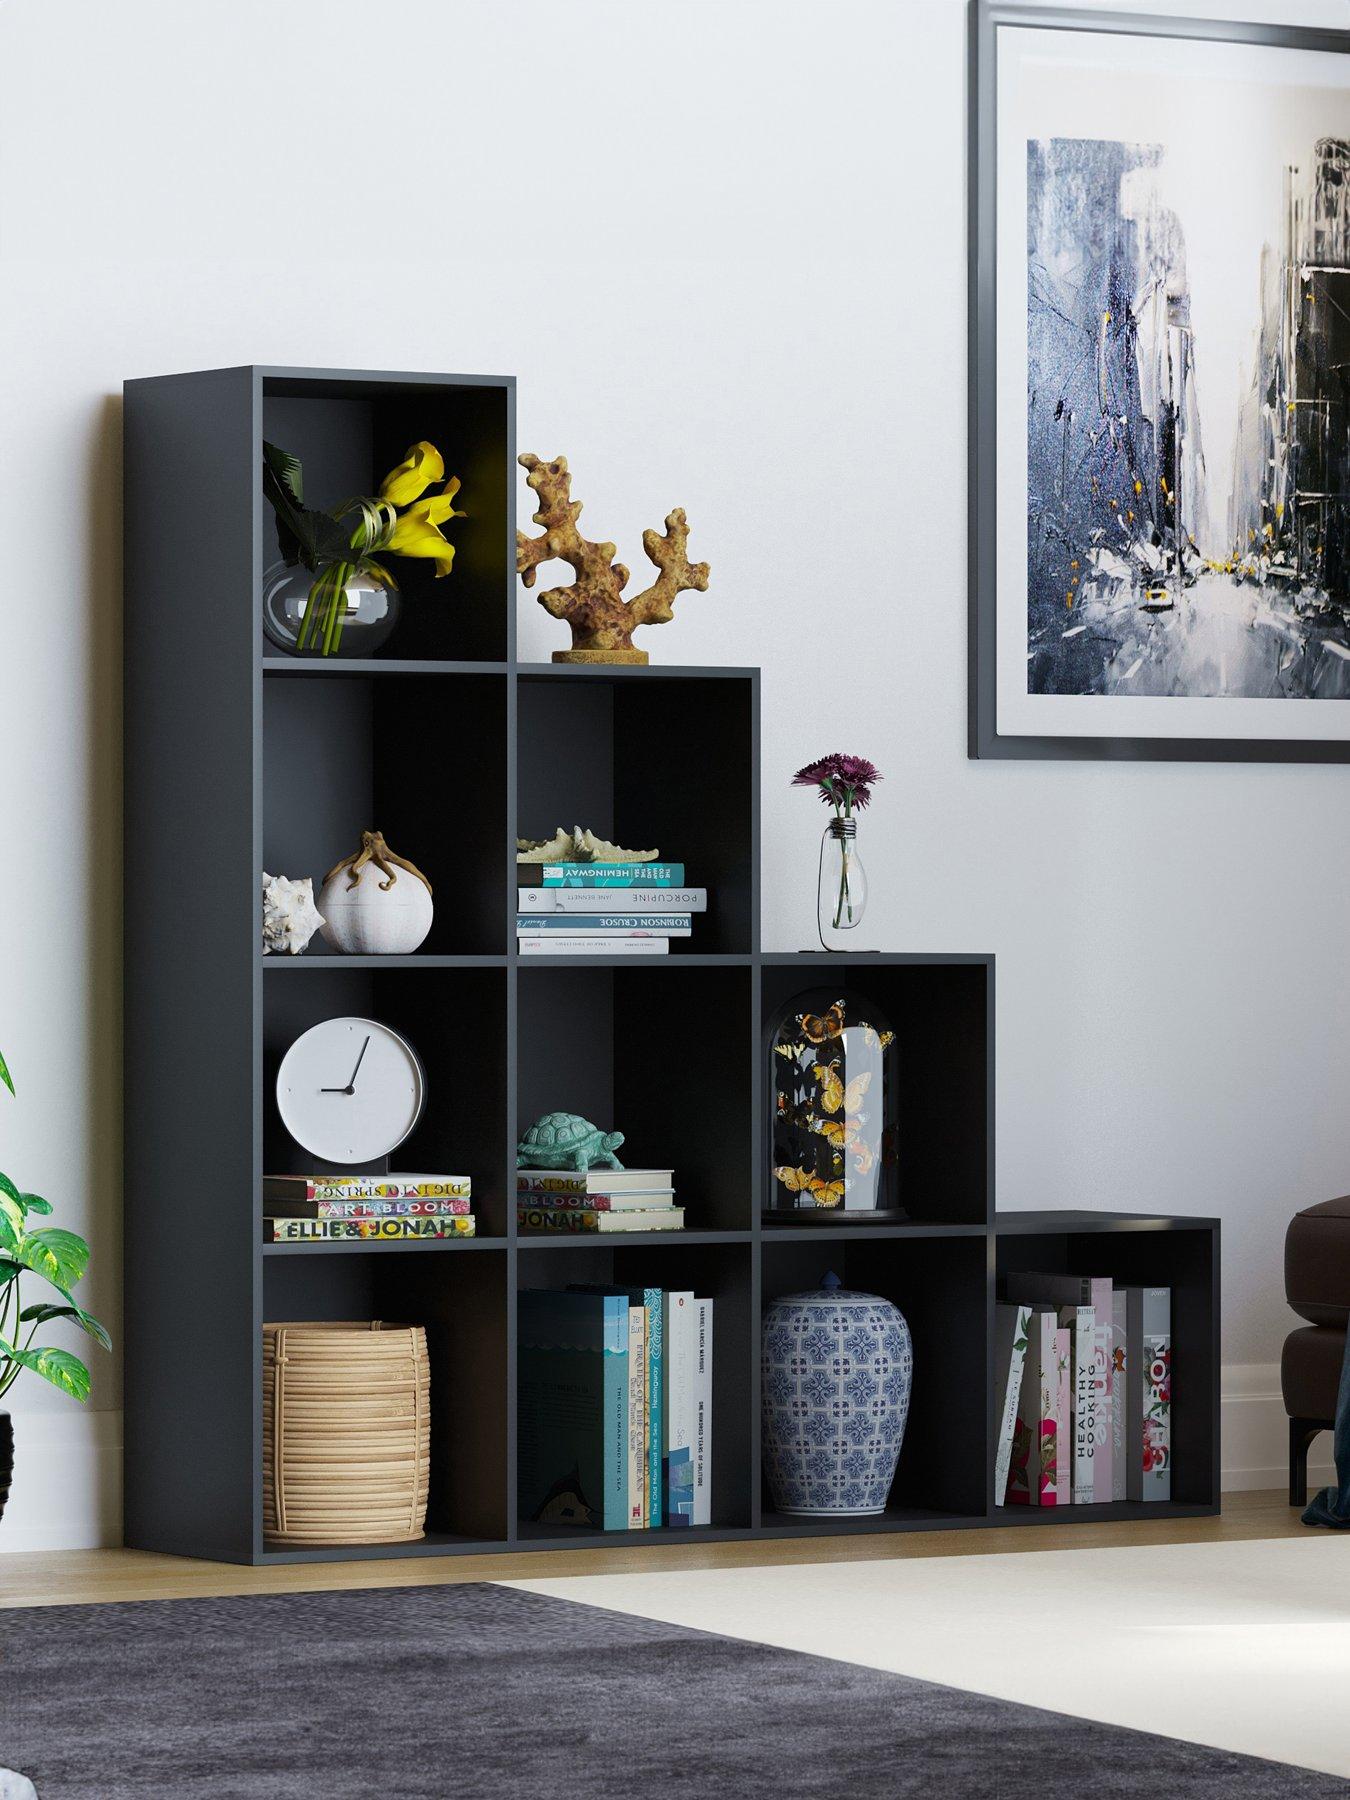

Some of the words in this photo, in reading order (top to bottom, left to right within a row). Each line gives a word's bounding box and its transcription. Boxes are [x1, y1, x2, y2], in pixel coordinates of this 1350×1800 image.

[565, 869, 629, 877] HEMINGWAY
[632, 893, 697, 902] PORCUPINE
[599, 918, 638, 927] CRUSOE
[640, 918, 689, 927] ROBINSON
[323, 1185, 382, 1198] SPRING
[434, 1183, 461, 1195] DIG
[328, 1203, 369, 1215] ART
[381, 1202, 455, 1214] BLOOM
[529, 1196, 595, 1207] BLOOM
[518, 1211, 584, 1227] JONAH
[370, 1219, 457, 1237] JONAH
[651, 1366, 659, 1409] Hemingway
[1094, 1322, 1113, 1447] frankie
[1087, 1364, 1096, 1458] COOKING
[1150, 1337, 1168, 1471] CHABON
[1077, 1366, 1086, 1458] HEALTHY
[676, 1428, 686, 1447] Sea
